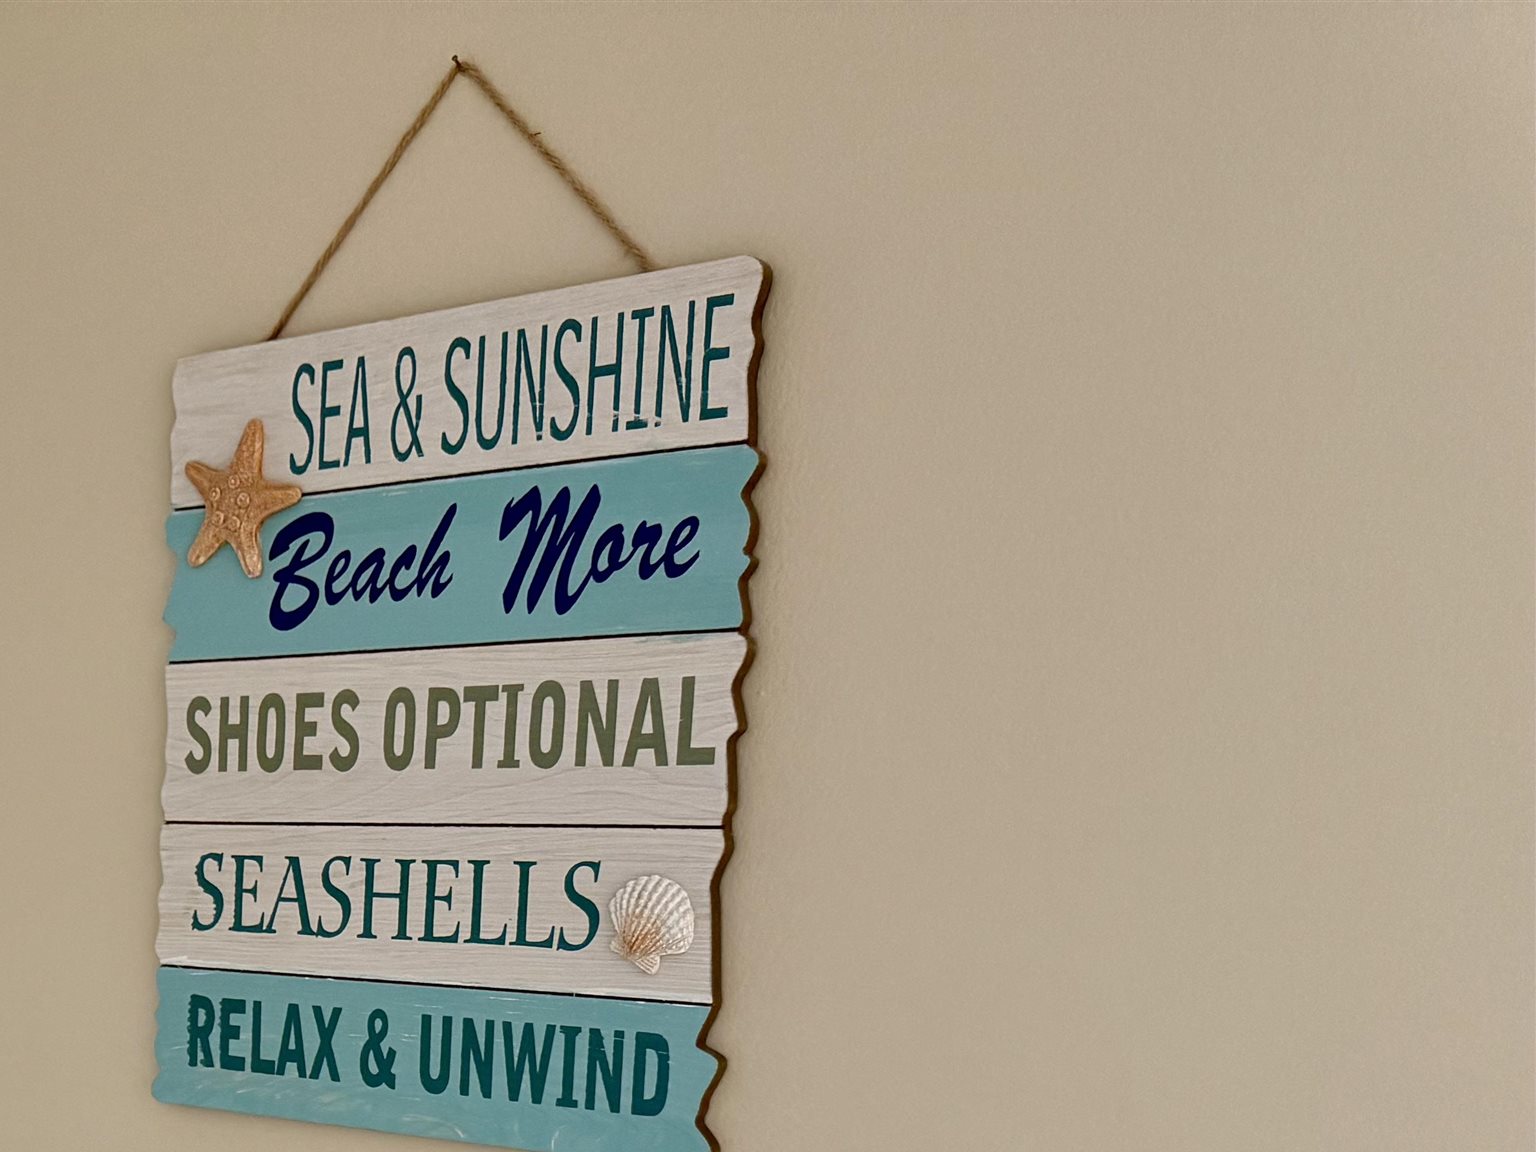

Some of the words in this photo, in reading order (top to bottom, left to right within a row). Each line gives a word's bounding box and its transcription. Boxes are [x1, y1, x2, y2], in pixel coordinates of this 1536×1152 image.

[289, 356, 372, 475] SEA
[390, 347, 425, 462] &
[441, 293, 735, 454] SUNSHINE
[268, 503, 458, 631] Beach
[498, 484, 700, 615] More
[184, 689, 360, 774] SHOES
[383, 676, 716, 771] OPTIONAL
[191, 852, 601, 952] SEASHELLS
[187, 994, 342, 1082] RELAX
[360, 1008, 397, 1090] &
[419, 1013, 670, 1116] UNWIND
